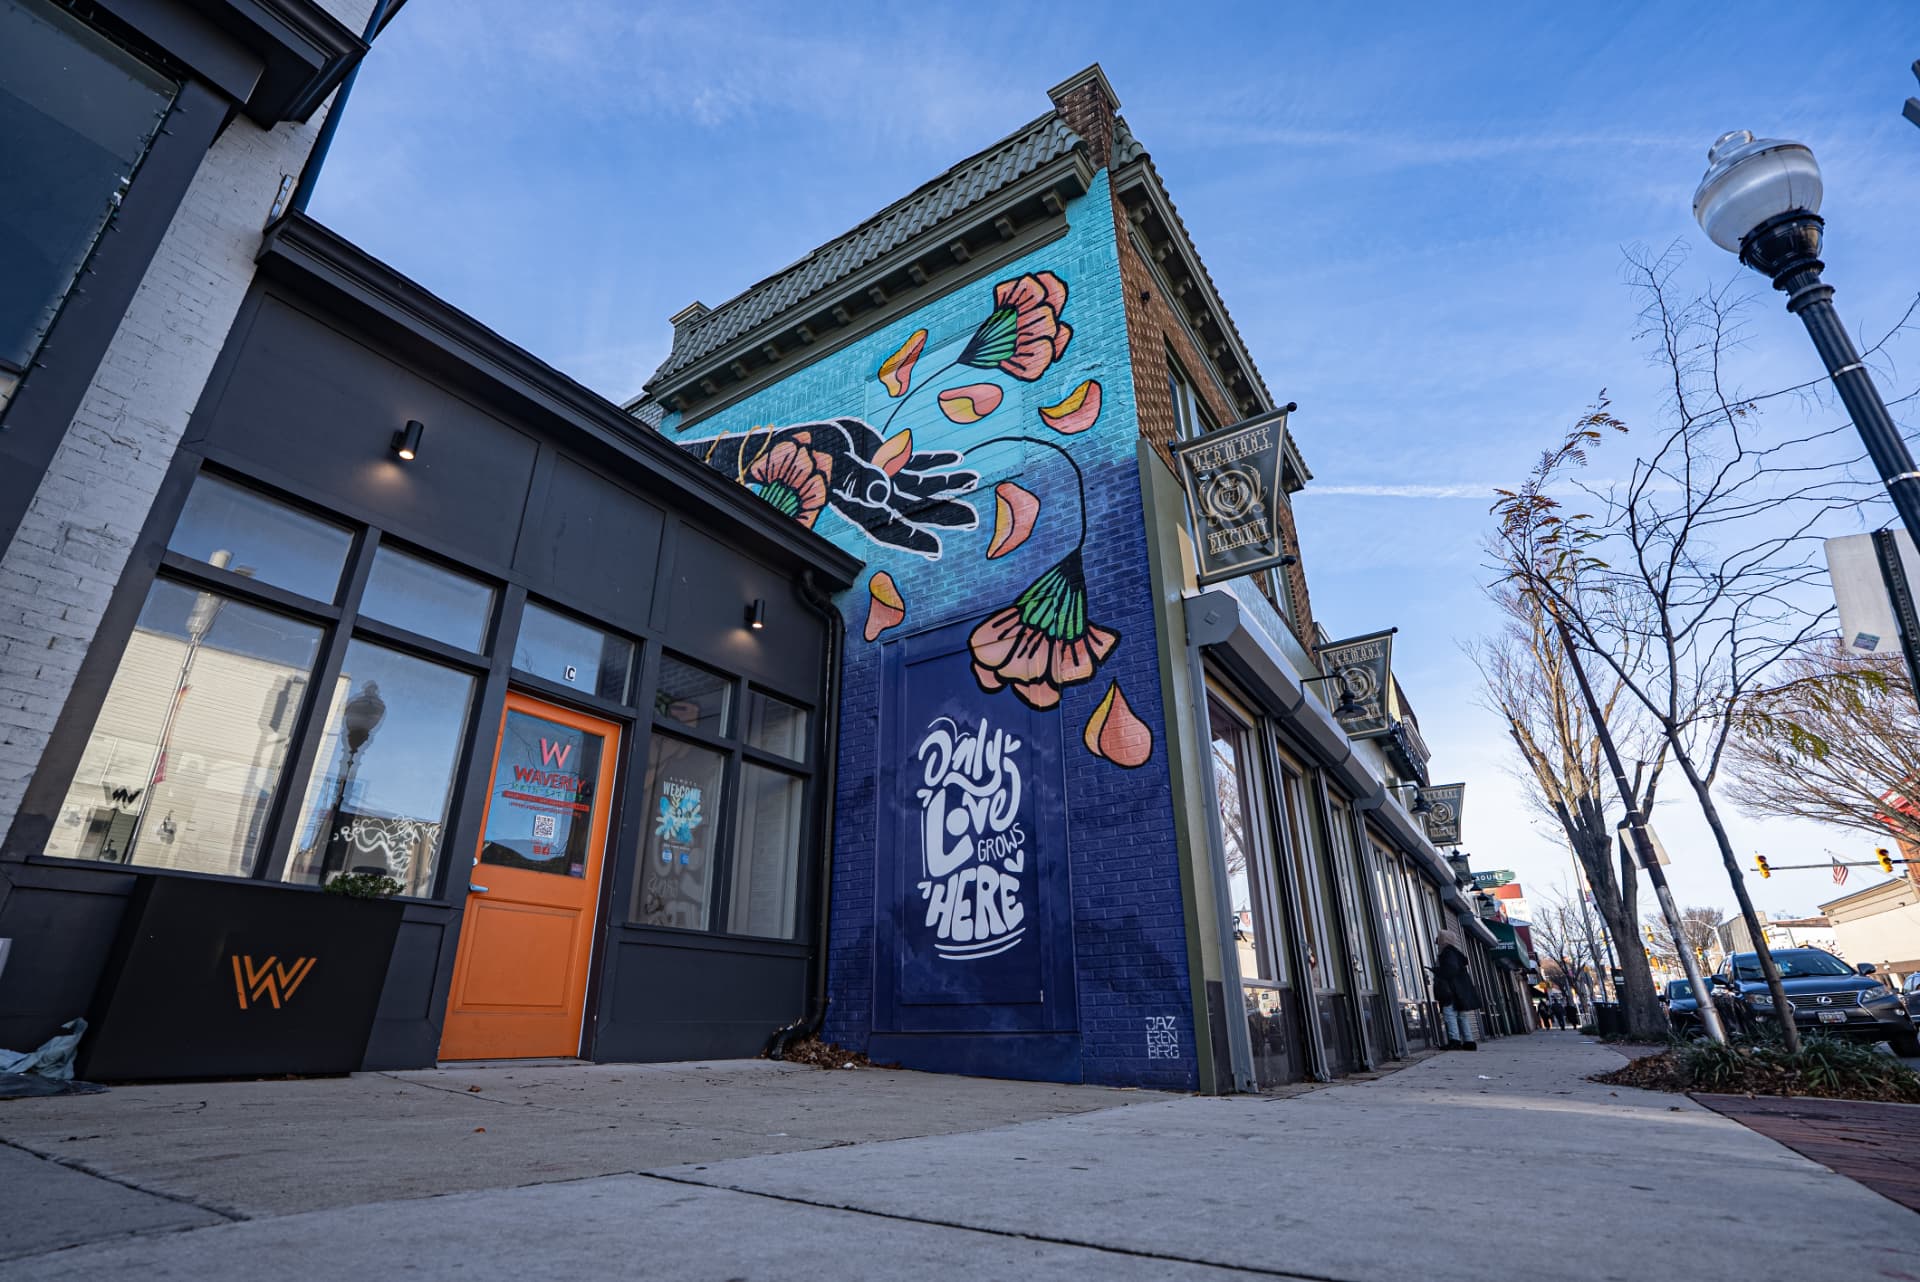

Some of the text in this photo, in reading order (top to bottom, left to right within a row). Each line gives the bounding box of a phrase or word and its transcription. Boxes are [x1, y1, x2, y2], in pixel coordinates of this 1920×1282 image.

[541, 737, 571, 769] W
[514, 764, 586, 793] WAVERLY
[977, 822, 1025, 862] GROWS
[917, 864, 1025, 941] HERE
[1145, 1016, 1176, 1030] JAZ
